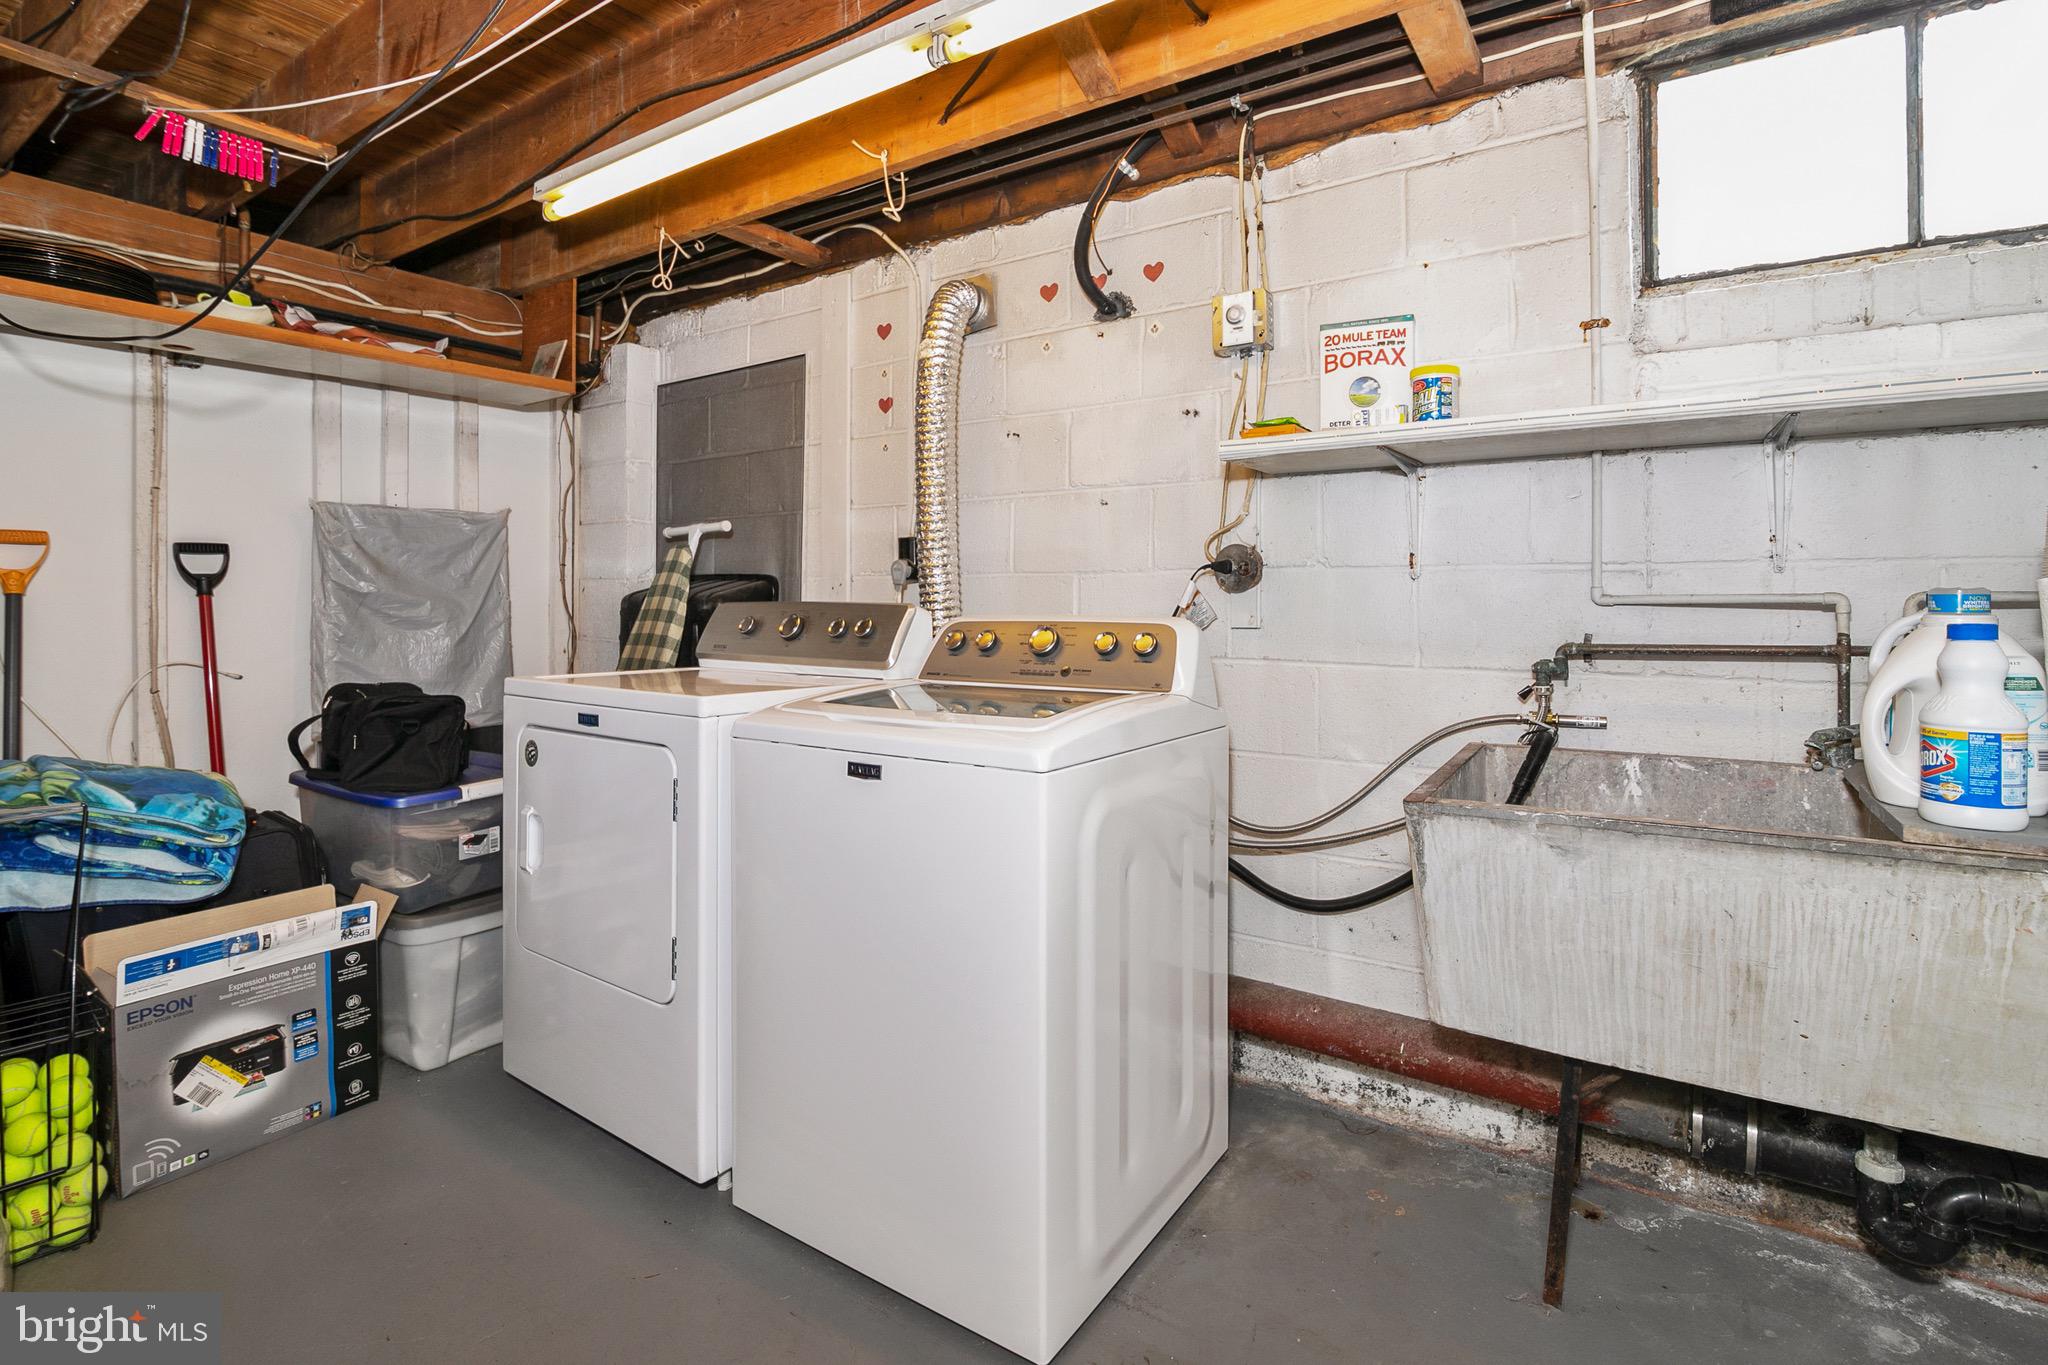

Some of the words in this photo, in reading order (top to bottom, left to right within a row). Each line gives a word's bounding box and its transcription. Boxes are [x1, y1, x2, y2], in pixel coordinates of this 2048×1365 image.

[1324, 335, 1341, 347] 20
[1342, 331, 1374, 344] MULE
[1376, 328, 1407, 340] TEAM
[1324, 347, 1407, 374] BORAX
[341, 928, 370, 941] EPSON
[228, 976, 268, 993] Expression
[269, 969, 290, 981] Home
[291, 962, 317, 975] XP-440
[127, 995, 193, 1026] EPSON
[127, 1020, 153, 1032] EXCEED
[155, 1015, 172, 1024] YOUR
[173, 1009, 194, 1019] VISION
